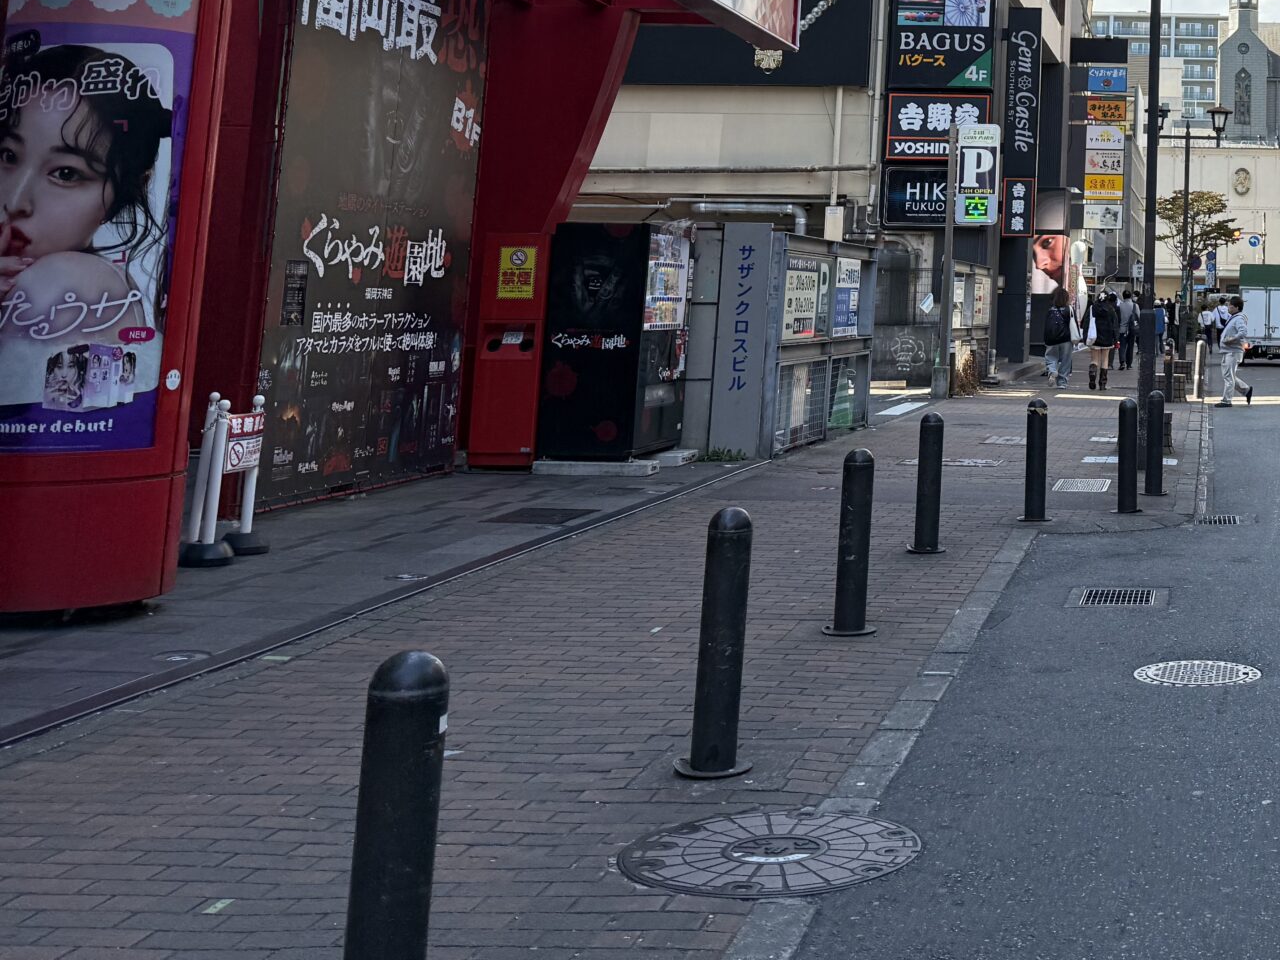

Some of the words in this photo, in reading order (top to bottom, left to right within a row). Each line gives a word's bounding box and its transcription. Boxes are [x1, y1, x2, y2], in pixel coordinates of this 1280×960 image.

[900, 32, 986, 52] BAGUS
[899, 54, 946, 67] バグース
[964, 65, 988, 82] 4F
[451, 96, 482, 146] B1F
[1014, 91, 1037, 153] Castle
[894, 141, 950, 155] YOSHIN
[960, 148, 994, 188] P
[905, 202, 945, 211] FUKUO
[965, 196, 988, 220] 空
[1011, 182, 1026, 231] 吉野家
[303, 213, 447, 287] くらやみ遊園地
[501, 271, 533, 286] 禁煙
[311, 311, 431, 334] 国内最多のホラーアトラクション
[728, 245, 755, 391] サザンクロスビル
[128, 330, 147, 339] NEW
[50, 419, 113, 433] debut!
